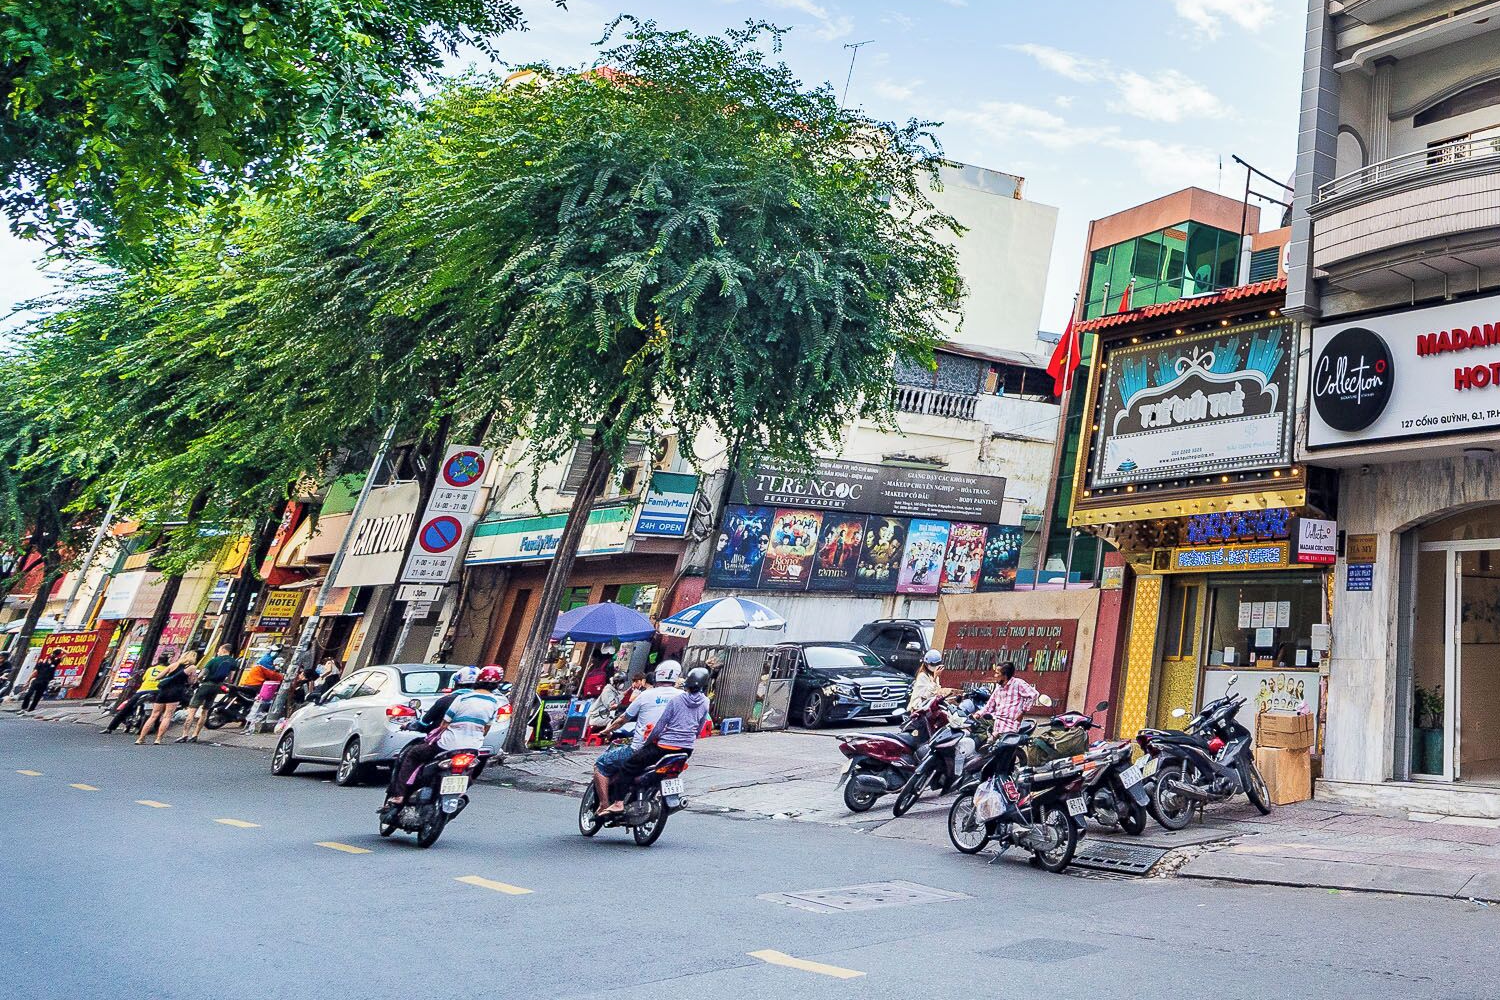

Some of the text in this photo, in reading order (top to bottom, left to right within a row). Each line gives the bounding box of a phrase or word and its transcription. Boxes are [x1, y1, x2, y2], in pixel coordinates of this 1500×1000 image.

[1401, 420, 1415, 429] 127
[1416, 414, 1439, 427] CỐNG
[648, 497, 689, 509] FamilyMart
[765, 495, 846, 507] BEAUTY ACADEMY
[640, 521, 682, 532] 24H OPEN
[353, 513, 415, 556] CARTOON
[1324, 544, 1335, 552] HOTEL
[268, 598, 296, 607] HOTEL
